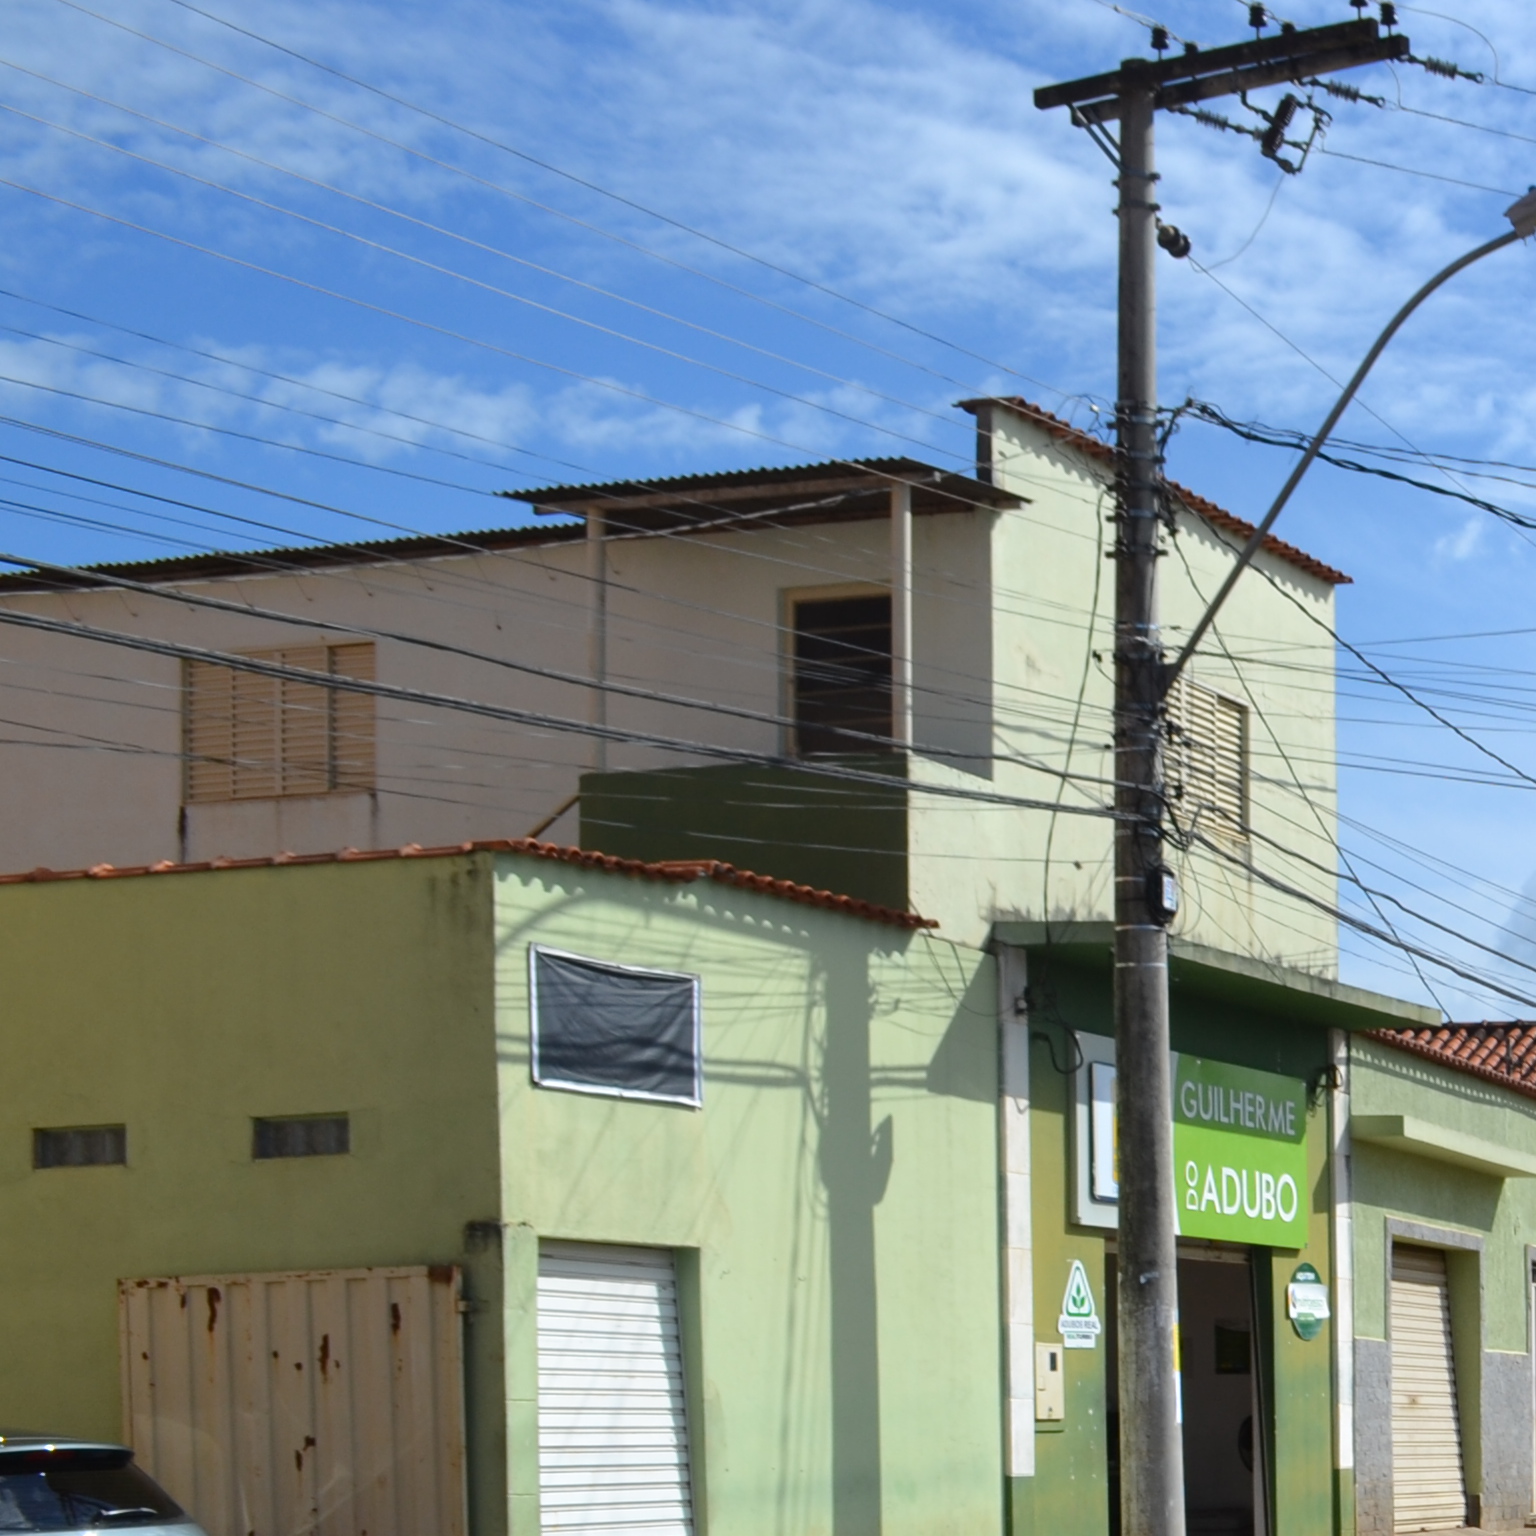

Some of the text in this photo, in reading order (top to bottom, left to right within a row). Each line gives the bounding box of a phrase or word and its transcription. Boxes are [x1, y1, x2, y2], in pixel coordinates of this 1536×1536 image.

[1181, 1080, 1296, 1136] GUILHERME
[1185, 1160, 1298, 1223] DO ADUBO
